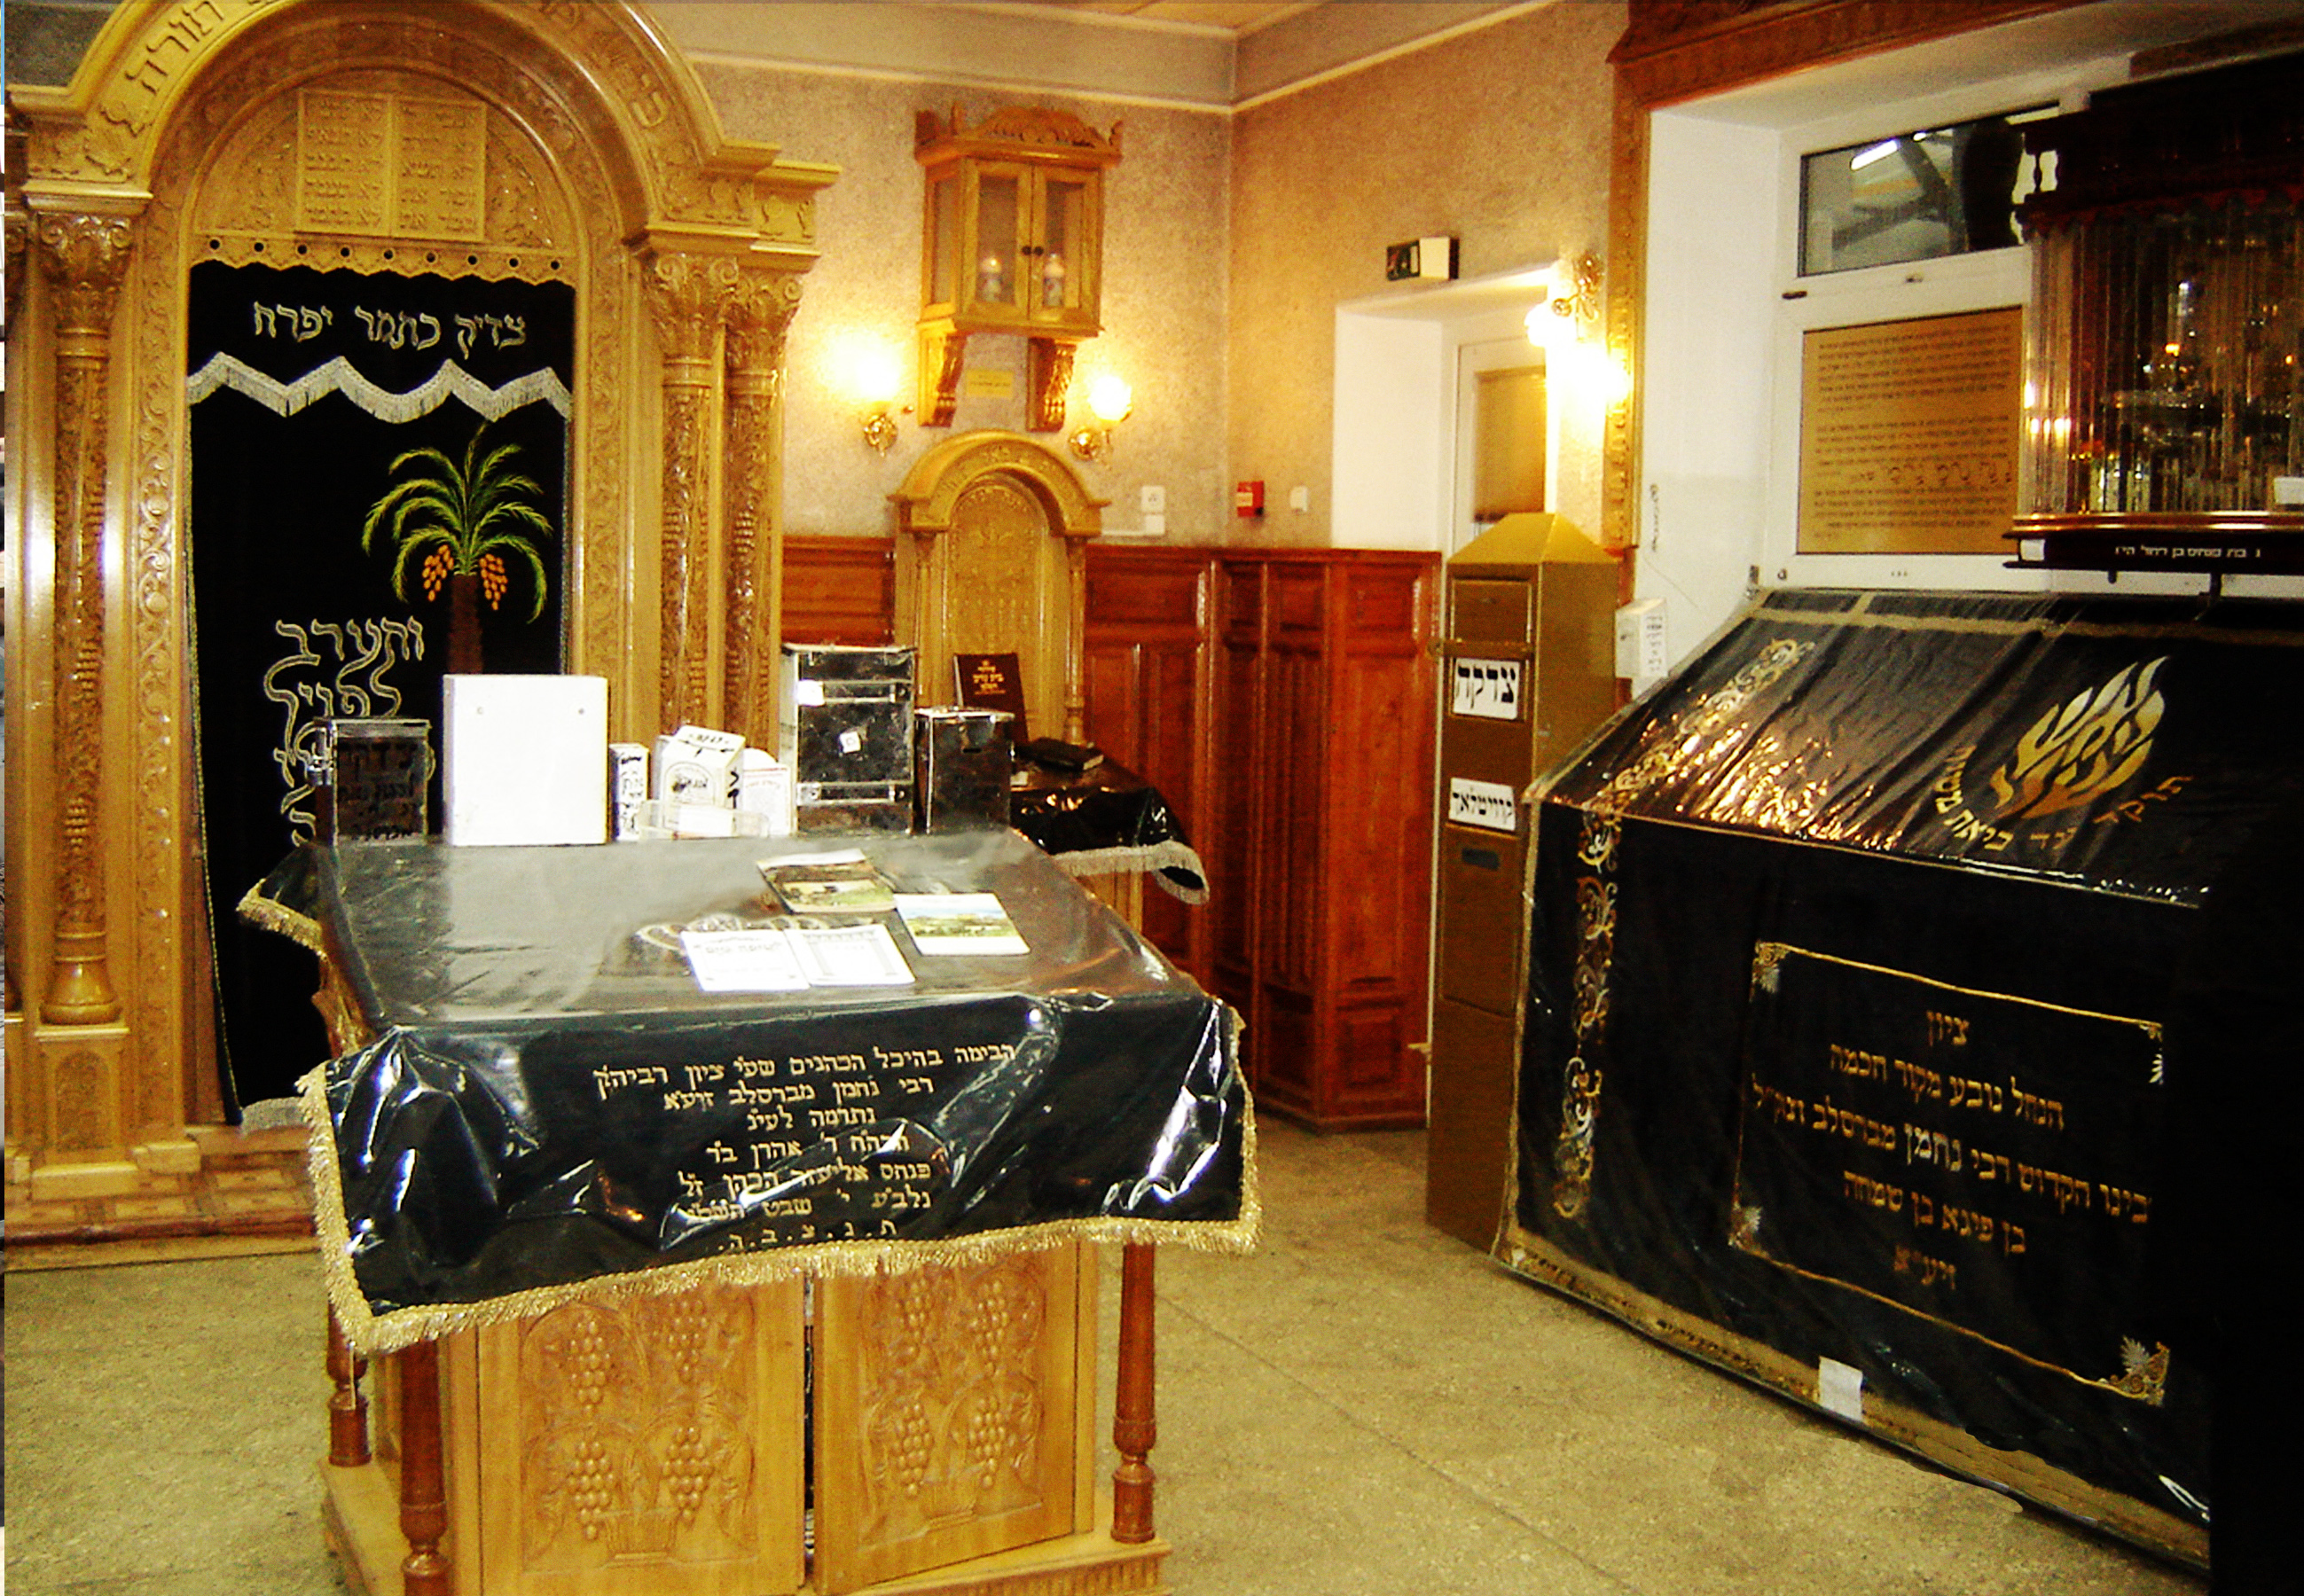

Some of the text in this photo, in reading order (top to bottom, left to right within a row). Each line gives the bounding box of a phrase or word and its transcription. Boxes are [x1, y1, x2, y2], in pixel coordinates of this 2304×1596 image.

[254, 300, 527, 360] צדיק כתמר יפרח
[1456, 665, 1516, 709] צדקה
[2092, 775, 2195, 824] תוקד
[1943, 808, 2015, 852] ביאת
[2030, 825, 2079, 851] עד
[1926, 1009, 1971, 1048] ציון
[788, 1053, 866, 1076] הכהנים
[873, 1045, 944, 1069] בהיכל
[953, 1043, 1017, 1064] הבימה
[685, 1064, 725, 1091] ציון
[728, 1080, 817, 1105] מברסלב
[897, 1076, 934, 1094] רבי
[1830, 1043, 2065, 1132] הנחל נובע מקור חכמה
[808, 1107, 877, 1129] נתרמה
[1812, 1093, 1897, 1151] מברסלב
[750, 1139, 803, 1170] אהרן
[1904, 1122, 1963, 1173] נחמן
[1971, 1147, 2010, 1185] רבי
[722, 1170, 780, 1202] הכהן
[879, 1162, 931, 1181] פנחס
[2017, 1162, 2092, 1216] הקדוש
[762, 1197, 813, 1218] שבט
[1843, 1169, 1904, 1213] שמחה
[1910, 1190, 1934, 1229] בן
[2098, 1182, 2153, 1224] בינו
[2001, 1219, 2026, 1258] בן
